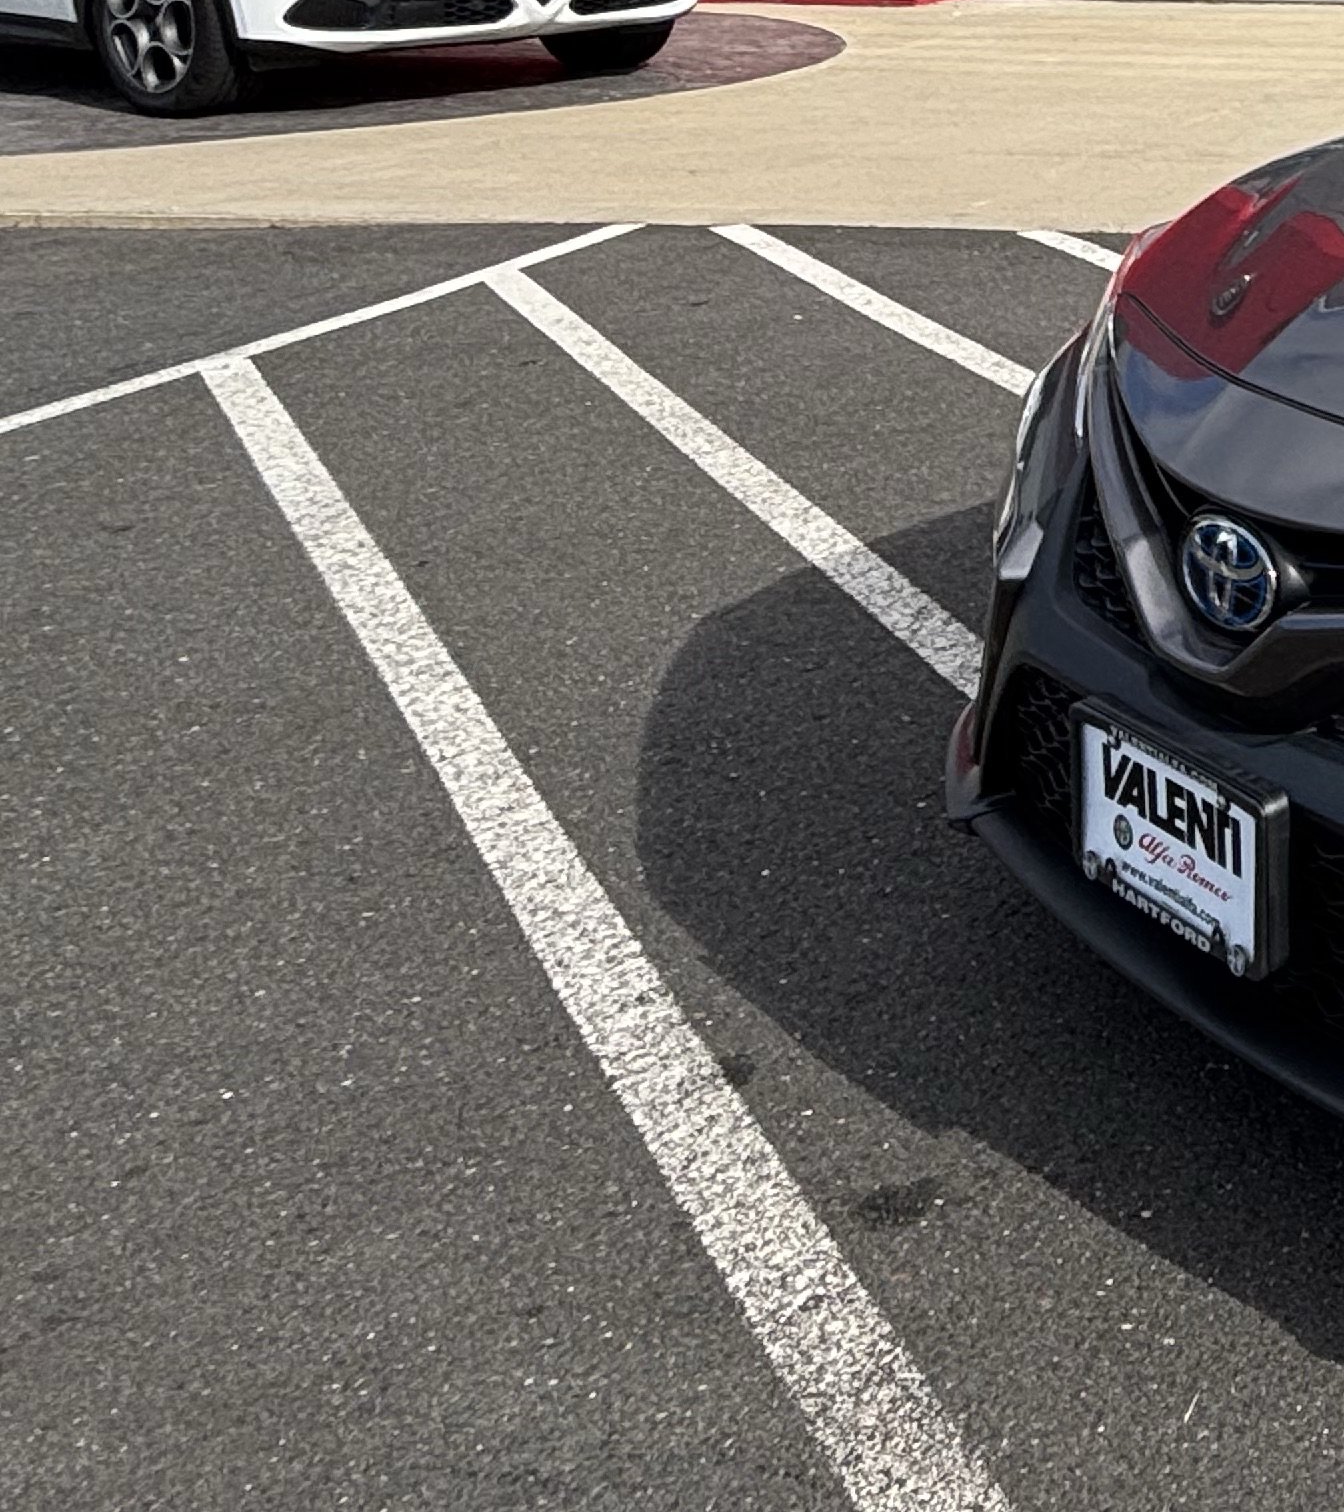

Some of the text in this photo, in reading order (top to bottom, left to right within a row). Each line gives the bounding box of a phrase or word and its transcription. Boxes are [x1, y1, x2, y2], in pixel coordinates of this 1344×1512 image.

[1101, 741, 1242, 878] VALENTI
[1138, 832, 1175, 865] Alfa
[1112, 878, 1211, 953] HARTFORD
